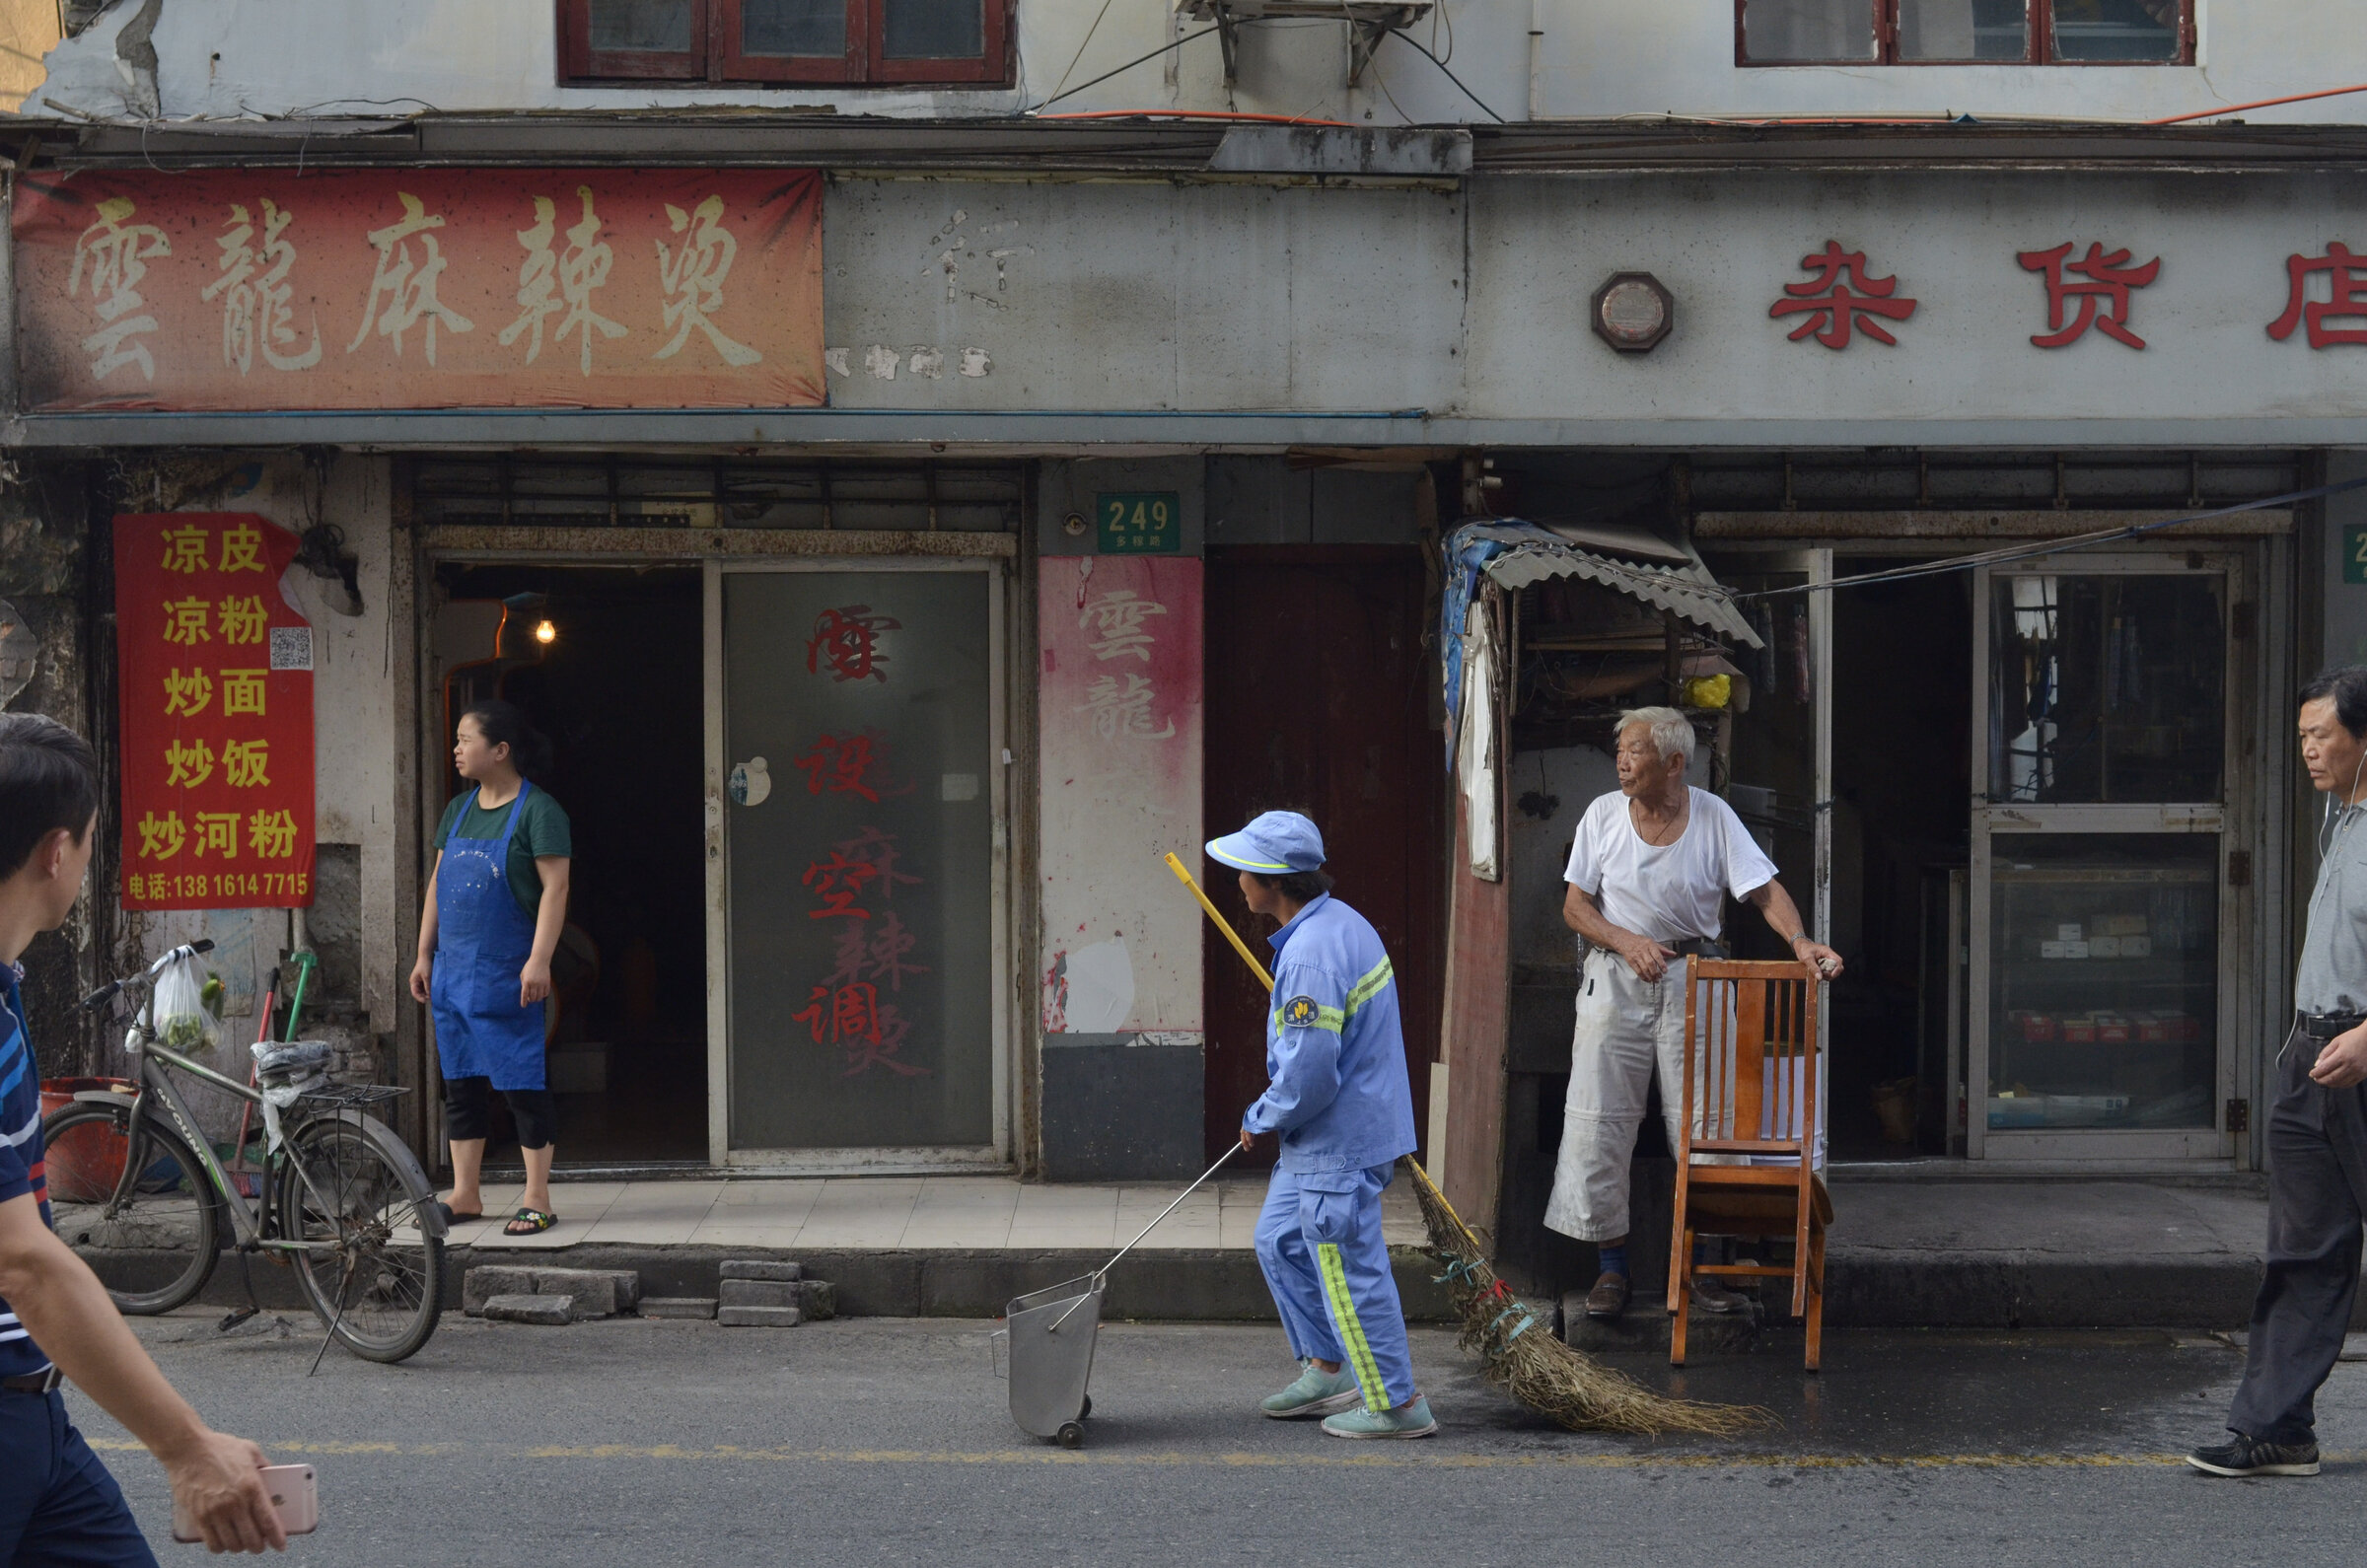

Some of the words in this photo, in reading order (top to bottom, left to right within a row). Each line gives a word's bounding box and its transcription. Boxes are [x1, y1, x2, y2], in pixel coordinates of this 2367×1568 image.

[1768, 239, 2367, 351] 杂货店
[1110, 501, 1169, 533] 249
[160, 523, 266, 574] 凉皮
[162, 594, 269, 646] 凉粉
[1073, 589, 1177, 741] 雲龍
[163, 667, 269, 718] 炒面
[164, 738, 271, 789] 炒饭
[137, 809, 298, 861] 炒河粉
[263, 873, 308, 896] 7715
